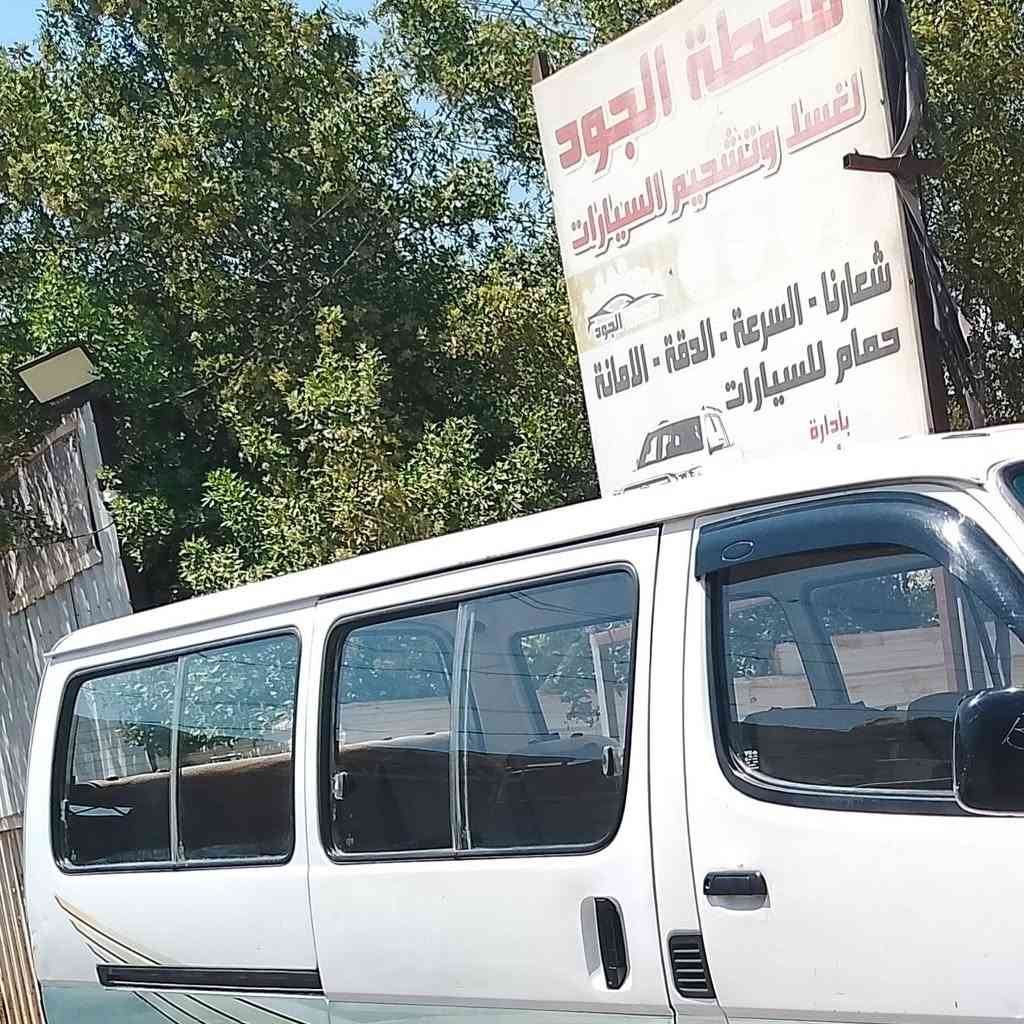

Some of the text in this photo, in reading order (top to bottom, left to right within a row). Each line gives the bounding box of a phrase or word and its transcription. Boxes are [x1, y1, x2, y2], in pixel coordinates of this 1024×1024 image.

[555, 0, 844, 175] محطة الجود
[571, 70, 866, 257] لغسل وتشحيم السيارات
[732, 281, 803, 352] السرعة
[821, 240, 892, 322] شعارنا
[594, 312, 623, 340] الجود
[664, 316, 716, 374] الدقة
[593, 343, 649, 399] الامانة
[725, 327, 901, 412] حمام للسيارات
